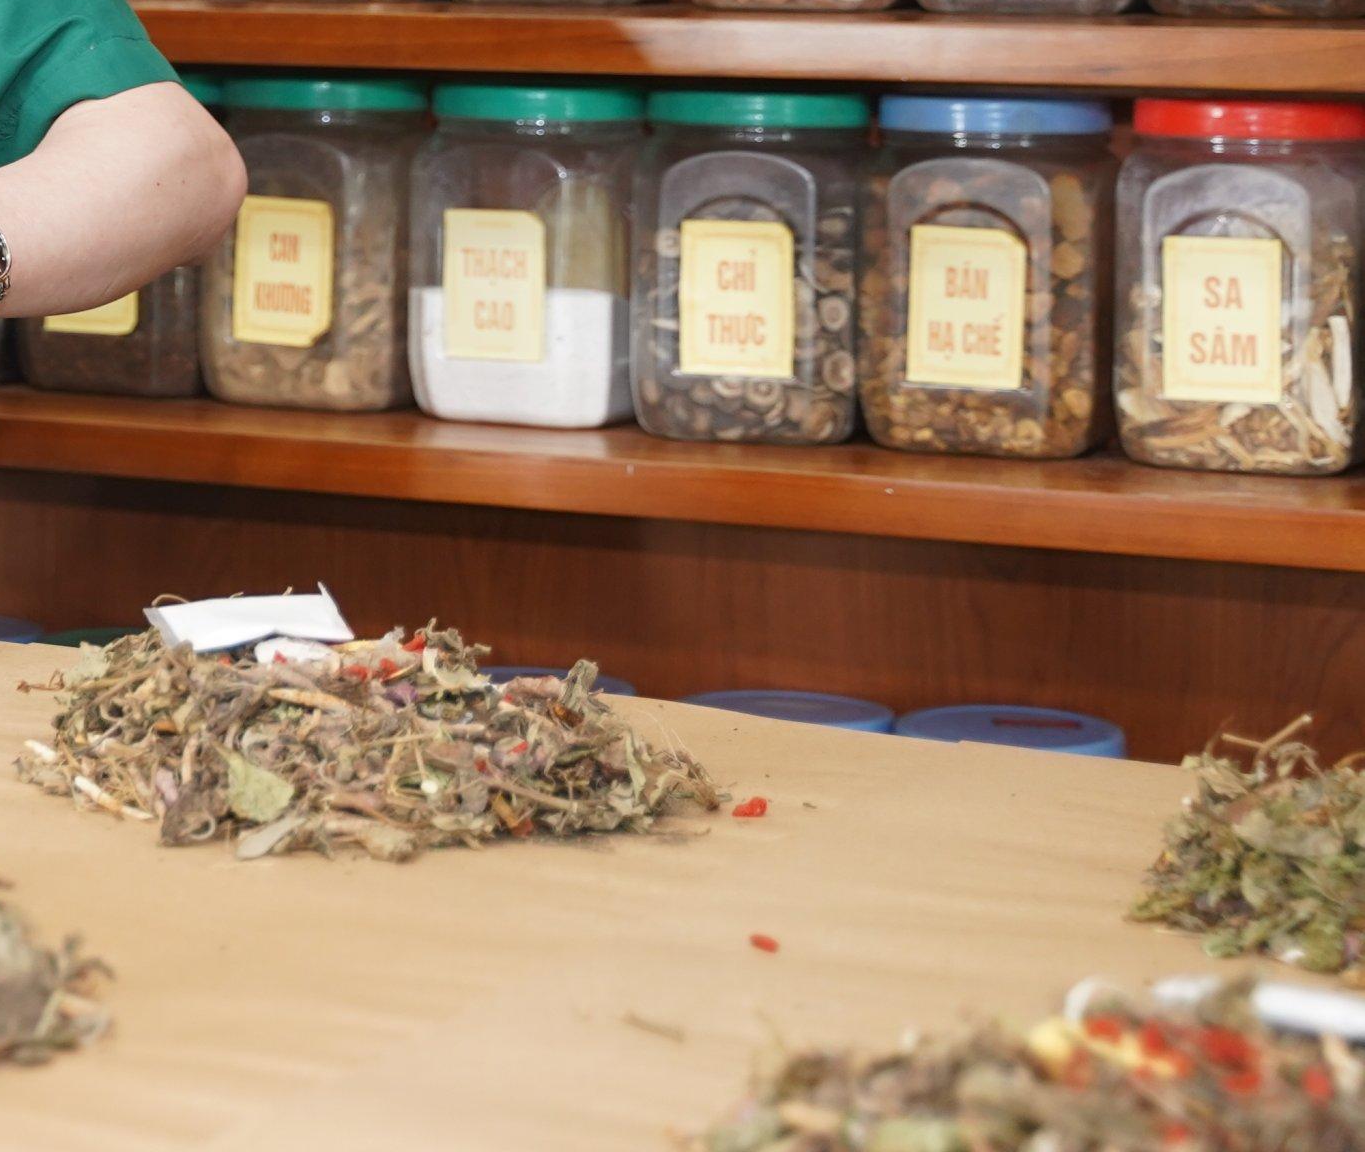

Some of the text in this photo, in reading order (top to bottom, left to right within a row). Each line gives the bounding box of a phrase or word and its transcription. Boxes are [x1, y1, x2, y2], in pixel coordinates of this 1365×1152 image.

[1203, 274, 1244, 309] SA
[473, 299, 516, 331] CAO
[1188, 325, 1259, 366] SÂM
